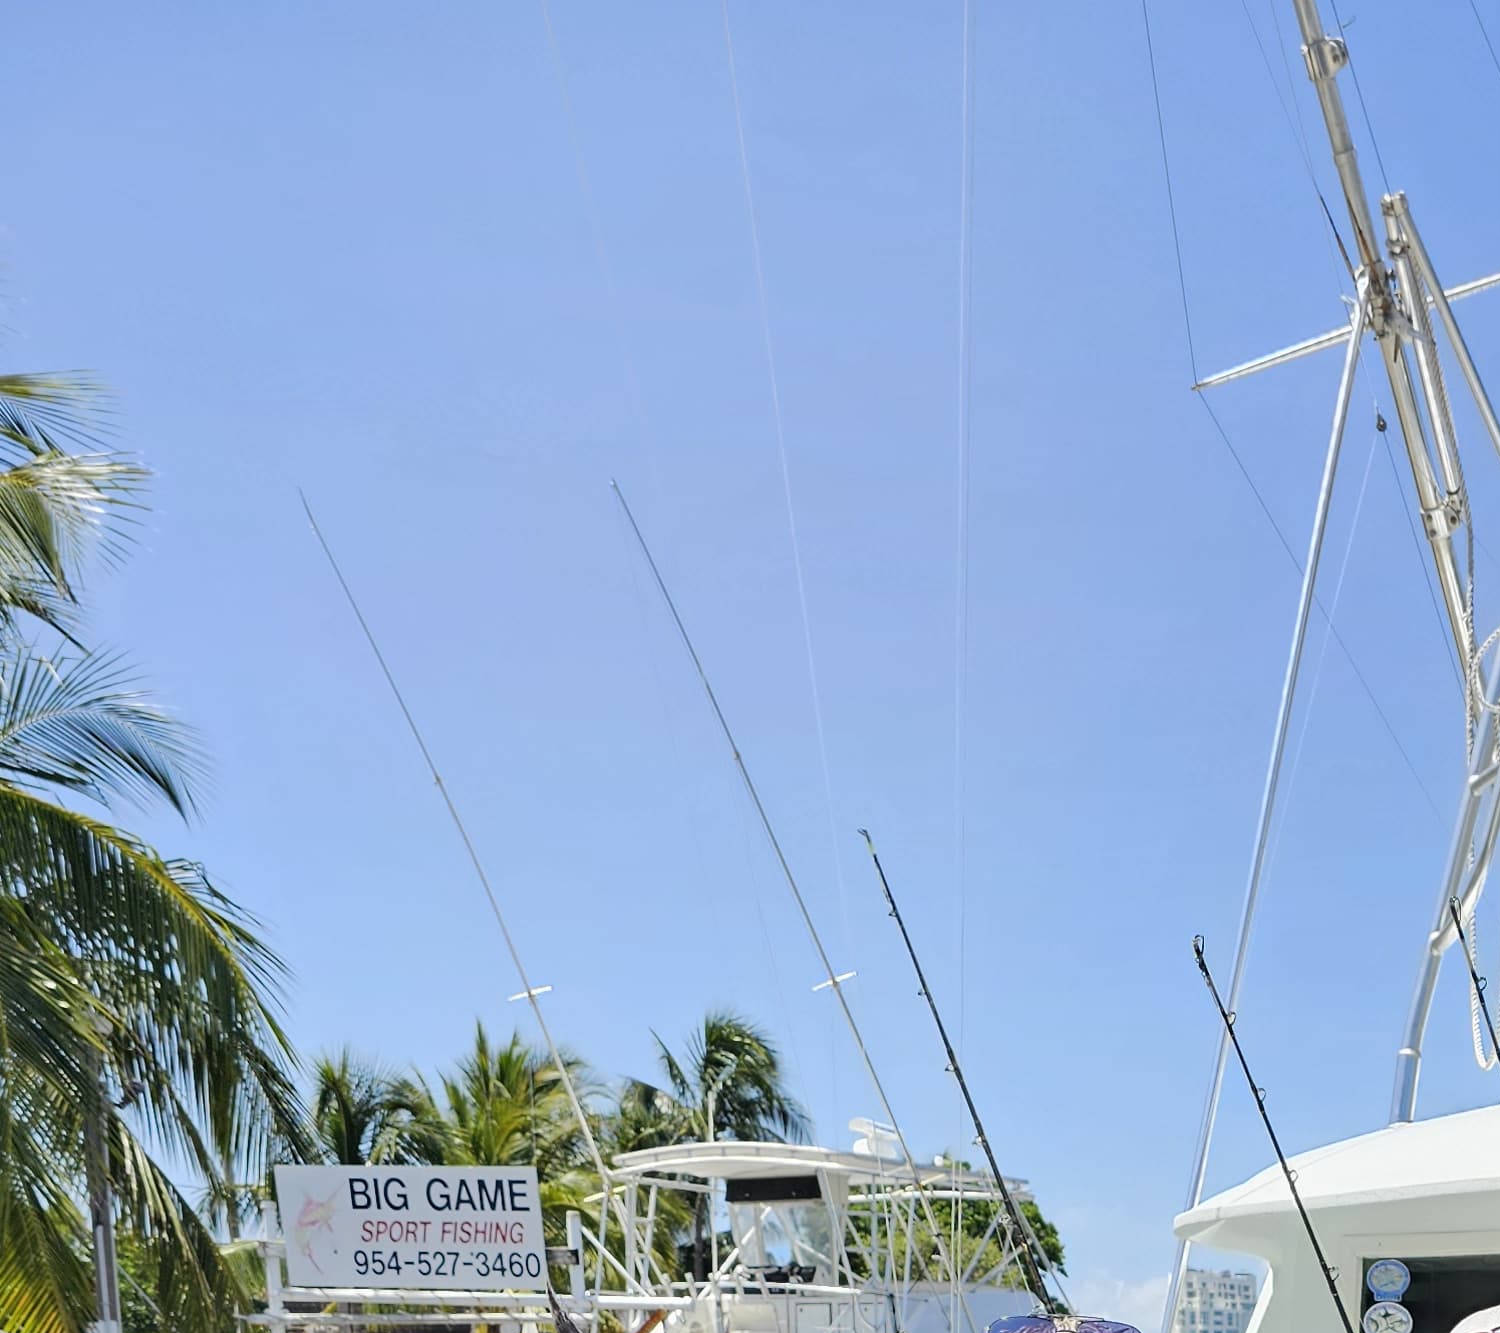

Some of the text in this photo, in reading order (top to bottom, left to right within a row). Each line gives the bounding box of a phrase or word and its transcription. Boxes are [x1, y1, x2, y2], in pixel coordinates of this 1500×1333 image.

[348, 1178, 530, 1212] BIG GAME
[361, 1220, 524, 1245] SPORT FISHING
[353, 1250, 541, 1278] 954-527-3460
